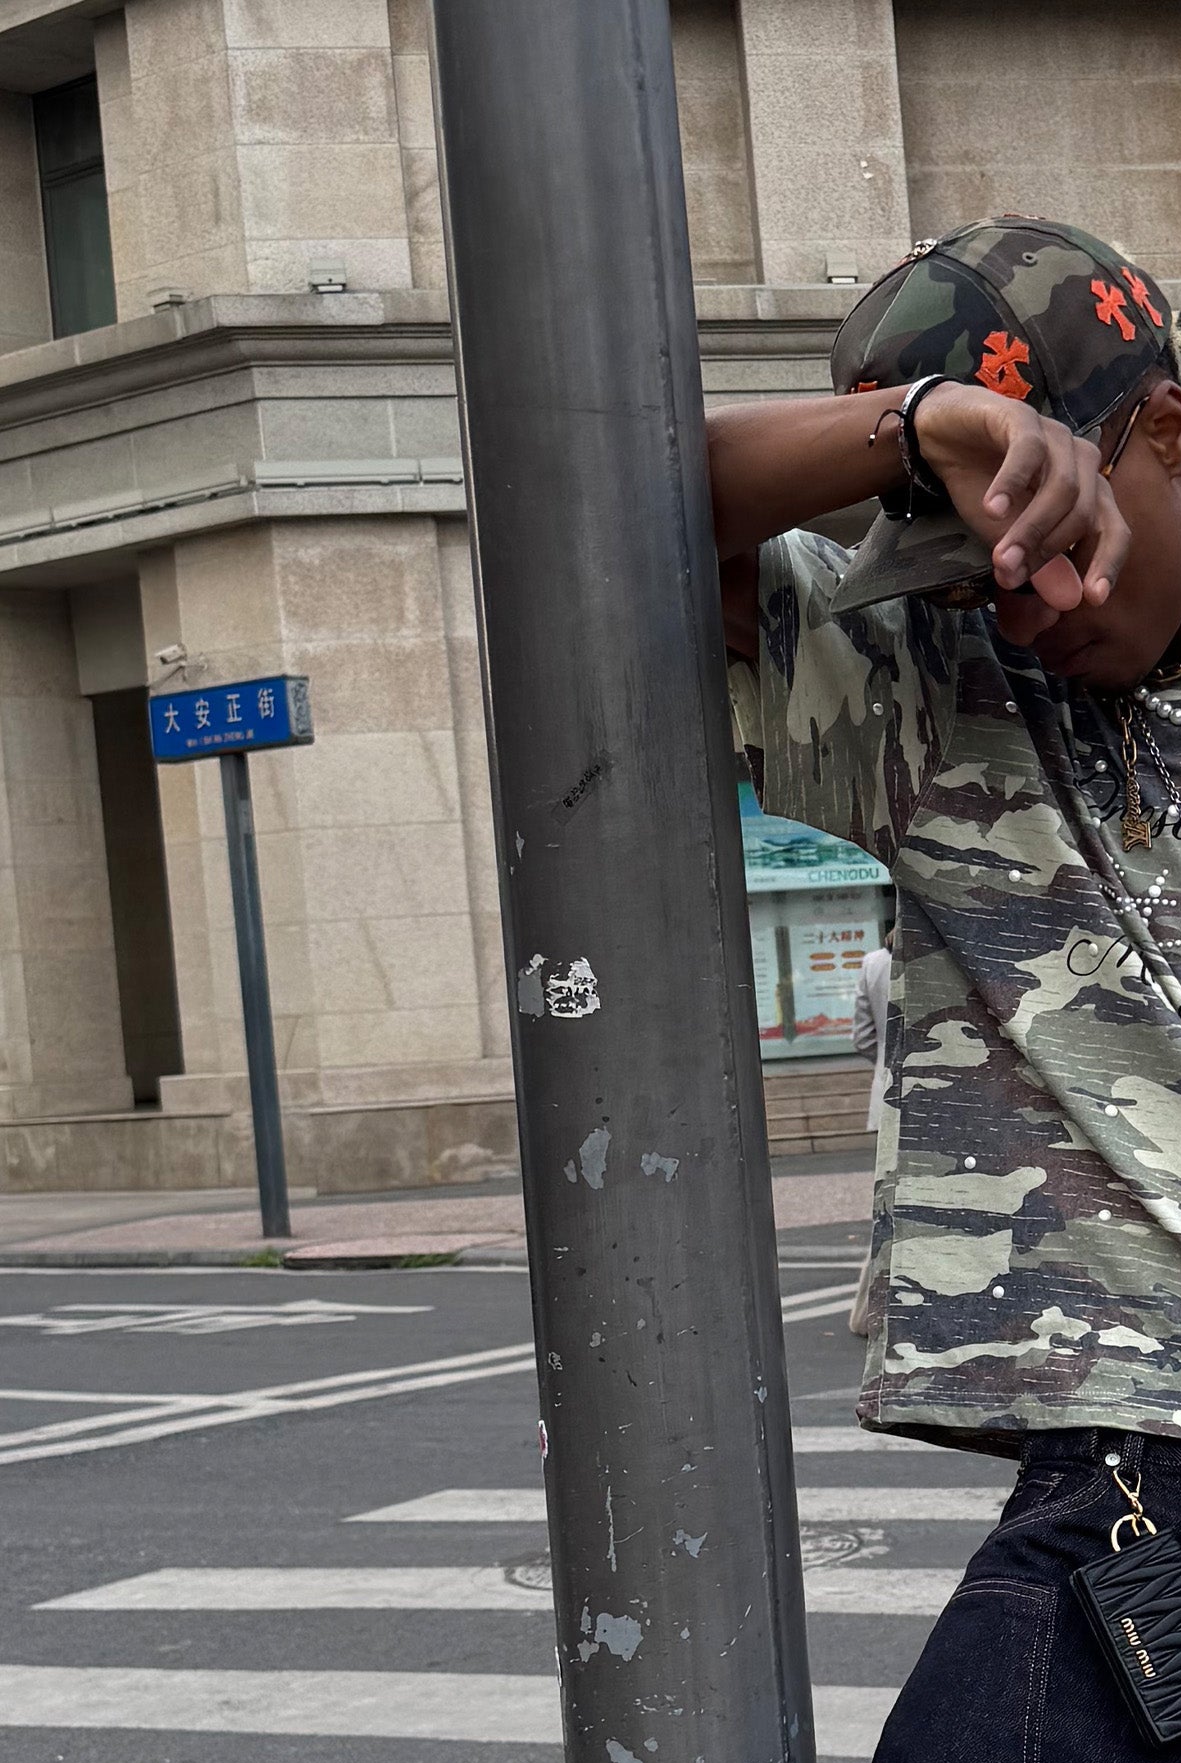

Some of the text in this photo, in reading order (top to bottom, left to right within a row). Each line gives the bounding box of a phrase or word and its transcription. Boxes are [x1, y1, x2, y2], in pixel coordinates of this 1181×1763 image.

[164, 688, 275, 733] 大安正街
[1121, 1617, 1156, 1678] miu miu
